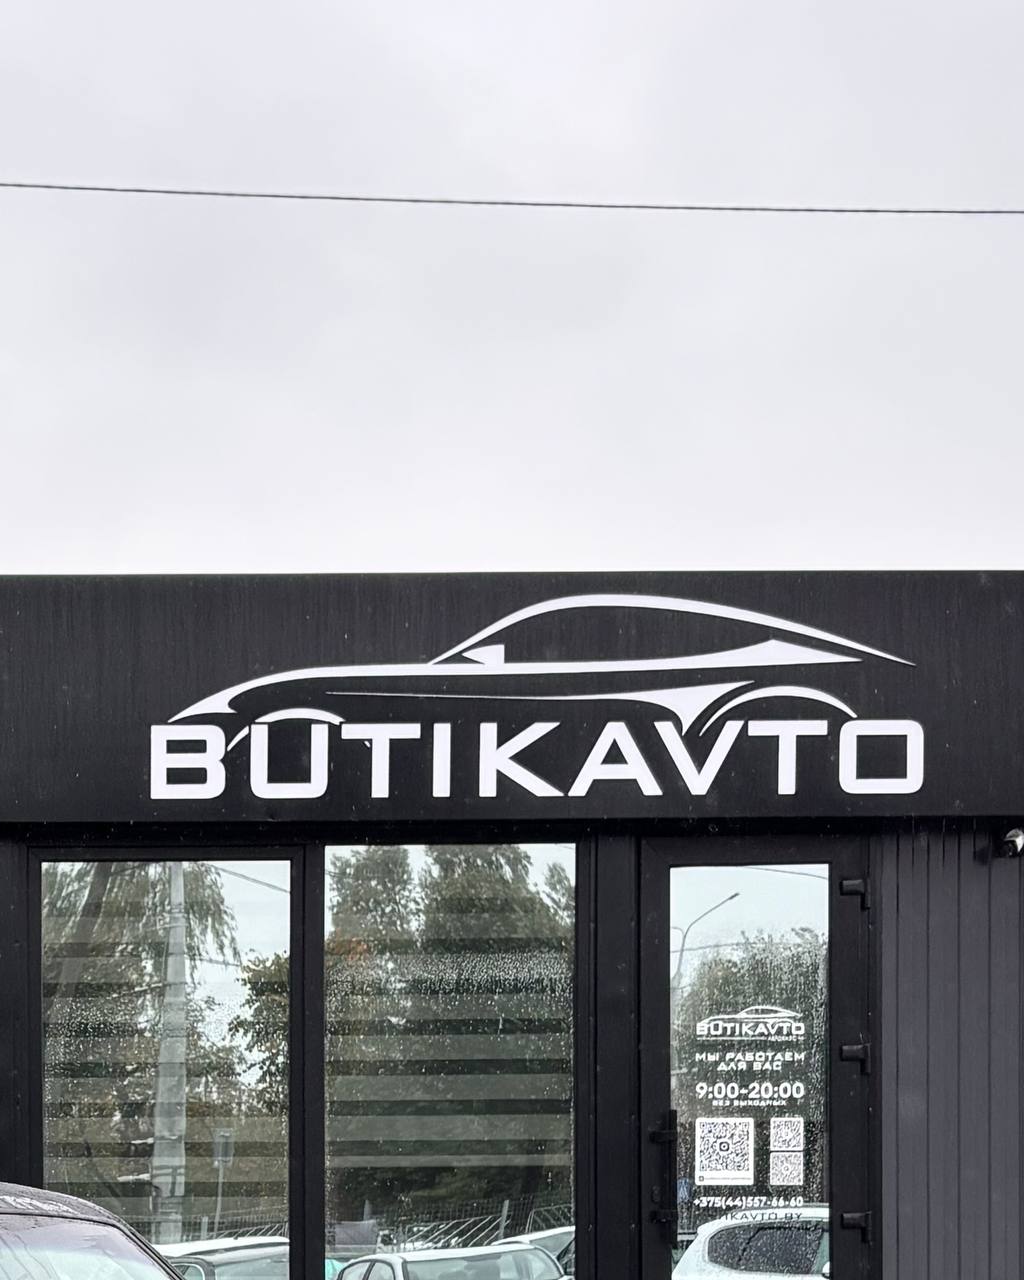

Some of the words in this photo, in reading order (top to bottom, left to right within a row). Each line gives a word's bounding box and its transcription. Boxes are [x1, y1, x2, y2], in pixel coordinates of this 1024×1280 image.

[150, 718, 924, 800] BUTIKAVTO
[696, 1022, 805, 1036] BUTIKAVTO
[695, 1052, 719, 1061] МЫ
[725, 1051, 805, 1061] РАБОТАЕМ
[717, 1062, 747, 1071] ДЛЯ
[753, 1062, 782, 1071] ВАС
[696, 1082, 805, 1099] 9:00-20:00
